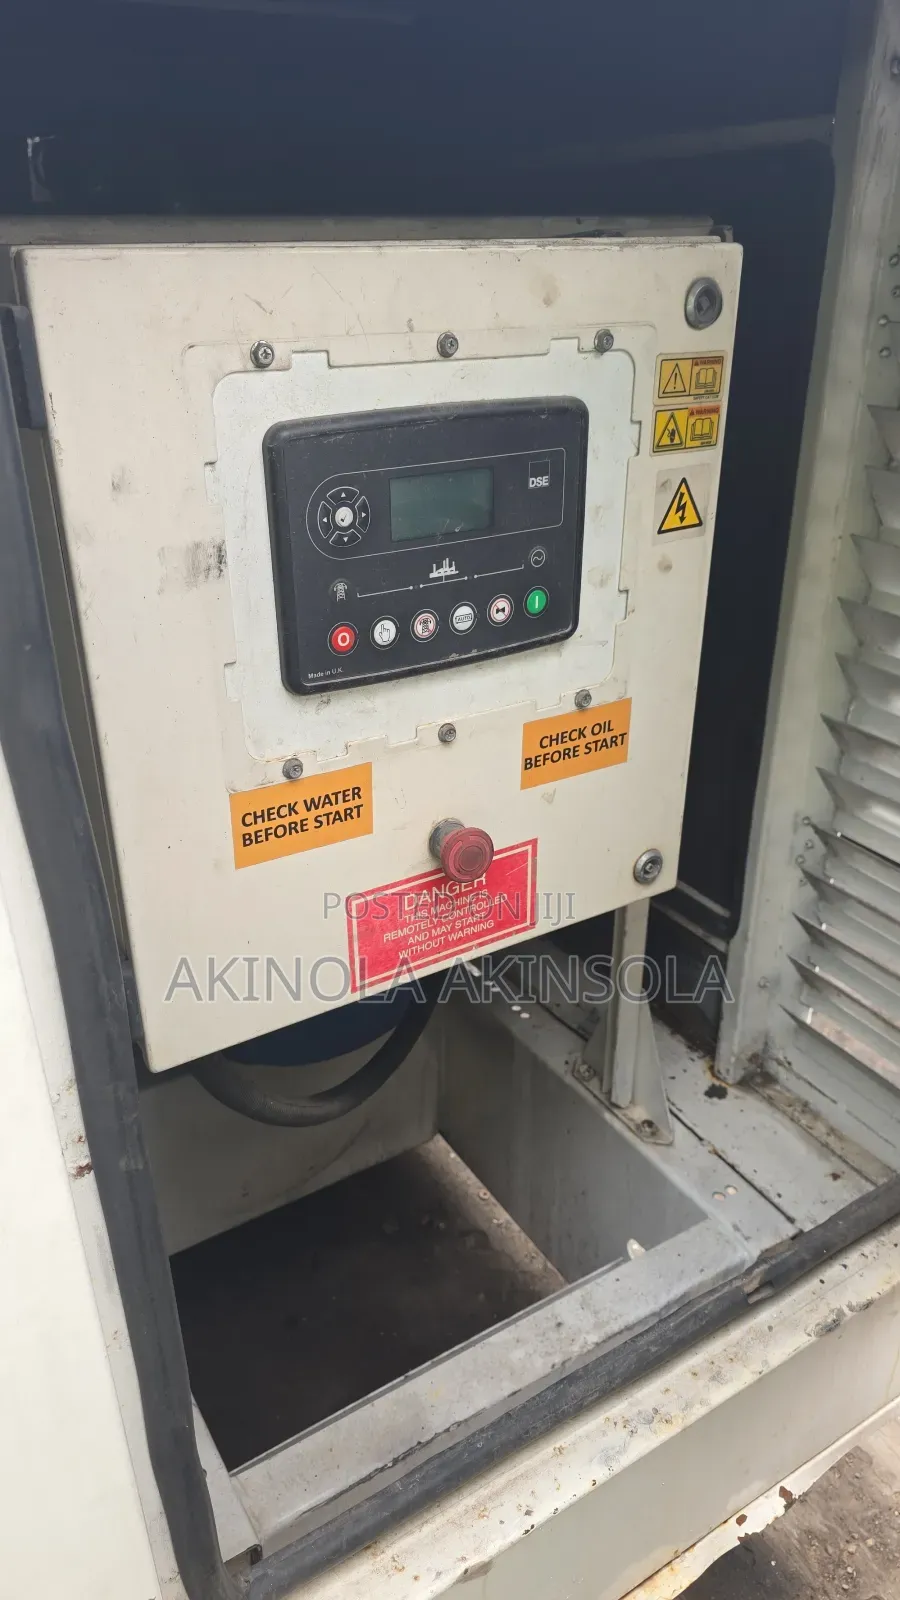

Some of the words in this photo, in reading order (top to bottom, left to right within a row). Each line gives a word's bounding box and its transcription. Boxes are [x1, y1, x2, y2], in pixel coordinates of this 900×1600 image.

[529, 476, 549, 488] DSE
[308, 671, 324, 679] Made
[524, 745, 580, 771] BEFORE
[584, 732, 627, 755] START
[540, 726, 588, 749] CHECK
[591, 720, 614, 736] OIL
[241, 801, 299, 828] CHECK
[303, 786, 362, 812] WATER
[242, 818, 309, 847] BEFORE
[314, 804, 364, 829] START
[404, 873, 487, 911] DANGER
[404, 909, 428, 924] THIS
[431, 895, 476, 915] MACHINE
[479, 889, 488, 899] IS
[383, 917, 438, 943] REMOTELY
[441, 893, 508, 923] CONTROLLED
[407, 931, 429, 945] AND
[431, 923, 453, 937] MAY
[455, 912, 487, 929] START
[398, 937, 445, 959] WITHOUT
[448, 919, 495, 942] WARNING
